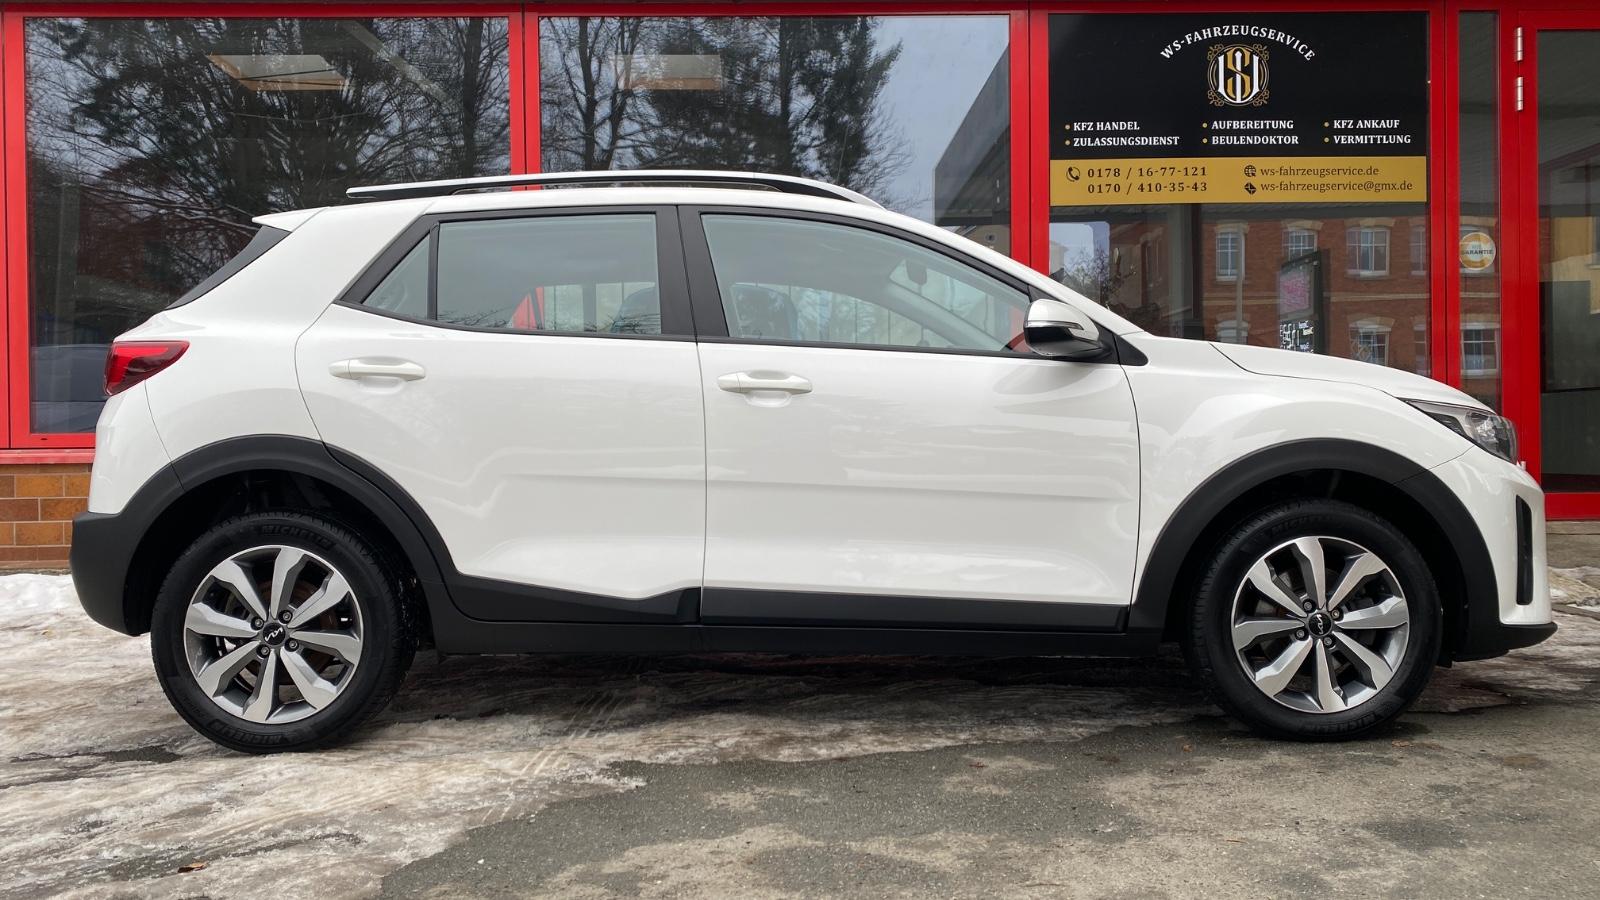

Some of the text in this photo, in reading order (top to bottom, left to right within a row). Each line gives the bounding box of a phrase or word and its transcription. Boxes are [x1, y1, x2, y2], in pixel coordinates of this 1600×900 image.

[1160, 25, 1315, 61] WS-FAHRZEUGSERVICE
[1074, 121, 1140, 131] KFZ HANDEL
[1211, 120, 1294, 130] AUFBEREITUNG
[1334, 119, 1400, 129] KFZ ANKAUF
[1073, 136, 1180, 147] ZULASSUNGSDIENST
[1211, 135, 1299, 145] BEULENDOKTOR
[1334, 134, 1411, 144] VERMITTLUNG
[1087, 168, 1121, 178] 0178
[1138, 166, 1207, 177] 16-77-121
[1260, 165, 1379, 180] ws-fahrzeugservice.de
[1087, 183, 1121, 194] 0170
[1137, 182, 1208, 193] 410-35-43
[1260, 181, 1413, 196] ws-fahrzeugservice@gmx.de
